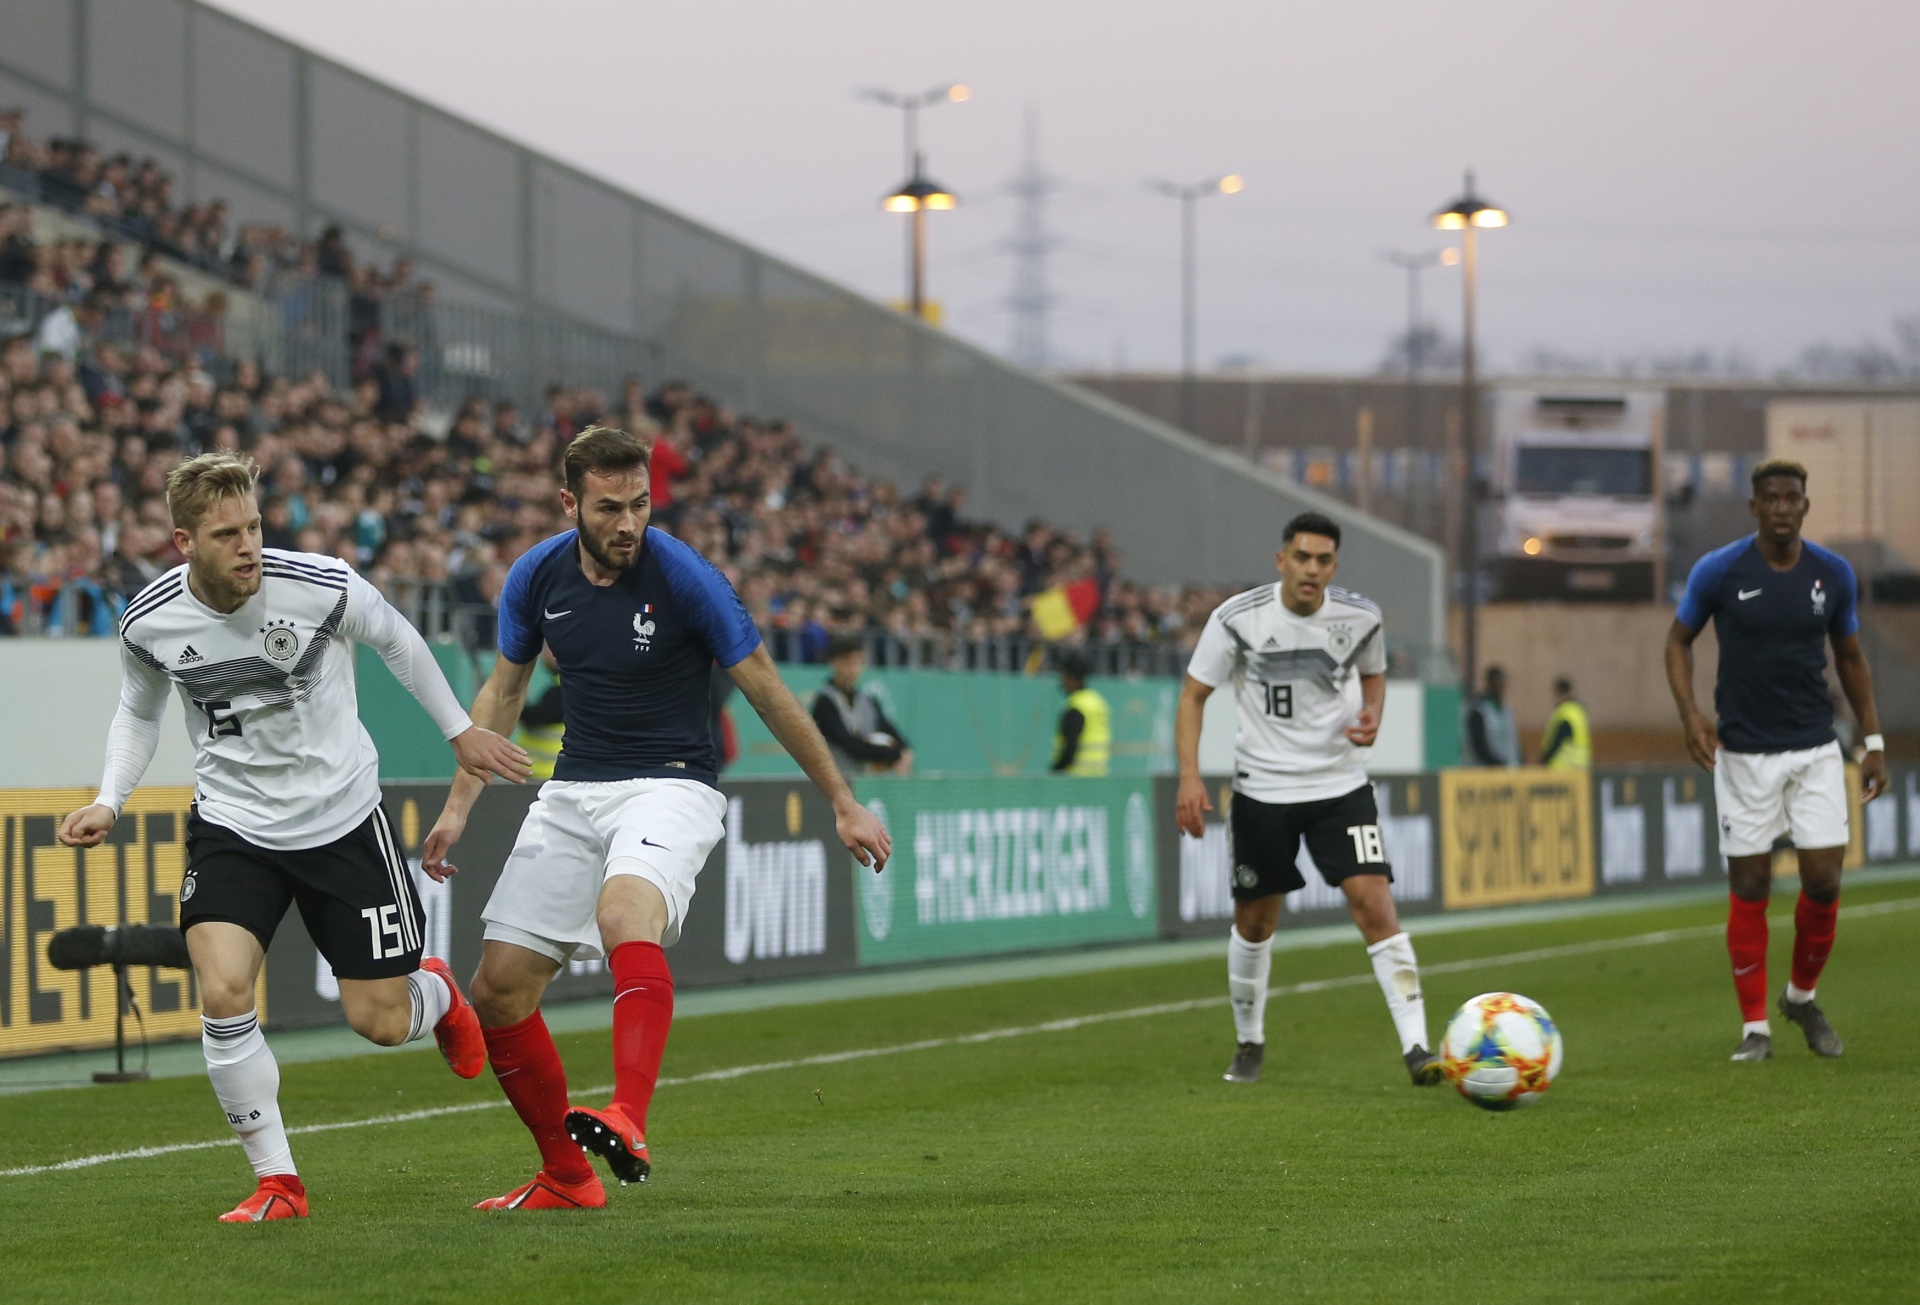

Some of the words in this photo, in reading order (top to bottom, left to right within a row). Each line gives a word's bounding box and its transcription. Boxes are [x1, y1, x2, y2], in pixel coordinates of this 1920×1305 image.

[177, 655, 204, 665] adidas
[634, 644, 651, 652] FFF
[192, 698, 243, 740] 15
[1260, 681, 1293, 718] 18
[1346, 824, 1385, 865] 18
[723, 790, 828, 964] bwin
[360, 903, 405, 961] 15
[226, 1109, 261, 1125] DFB
